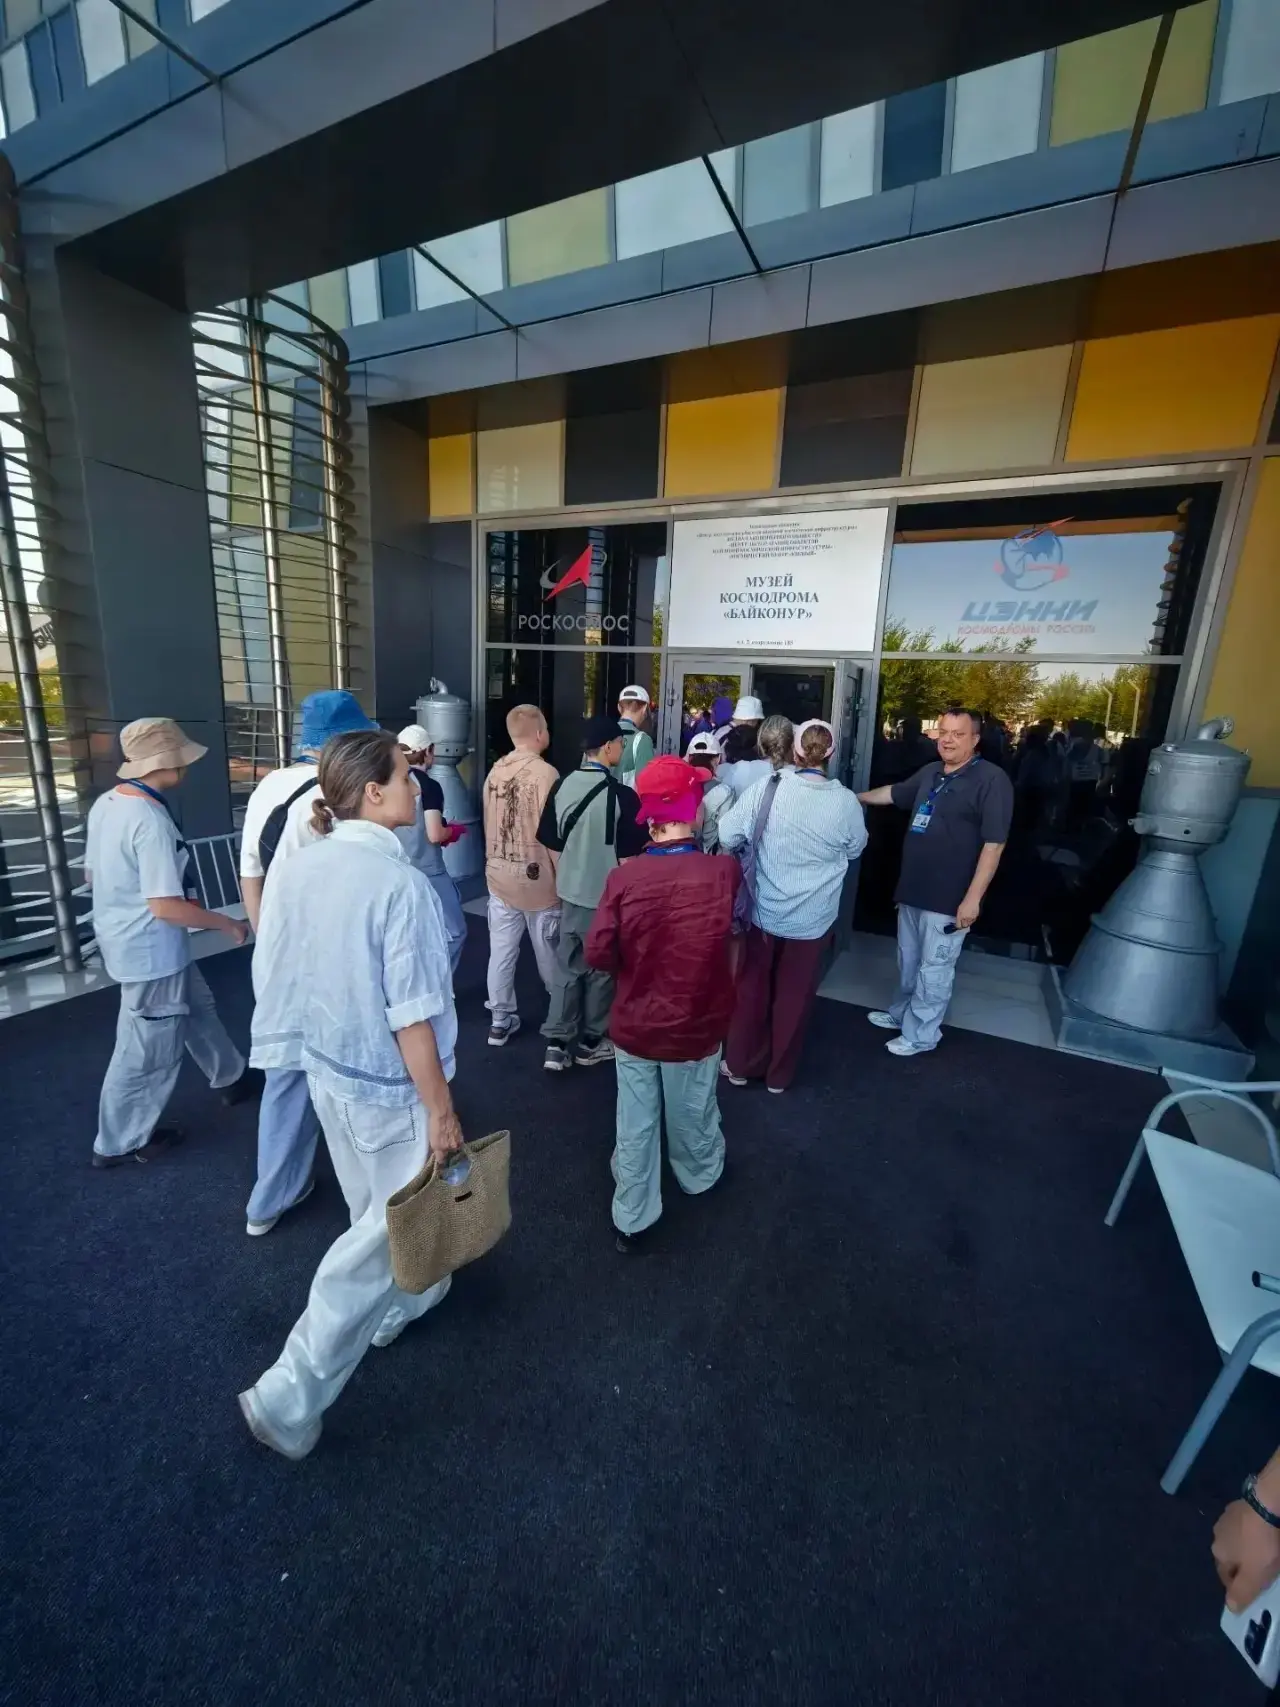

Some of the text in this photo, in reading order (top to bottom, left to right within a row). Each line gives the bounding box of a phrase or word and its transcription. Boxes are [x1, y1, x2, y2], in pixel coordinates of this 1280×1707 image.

[745, 573, 793, 588] МУЗЕЙ
[719, 591, 820, 605] КОСМОДРОМА
[723, 604, 813, 620] «БАЙКОНУР»
